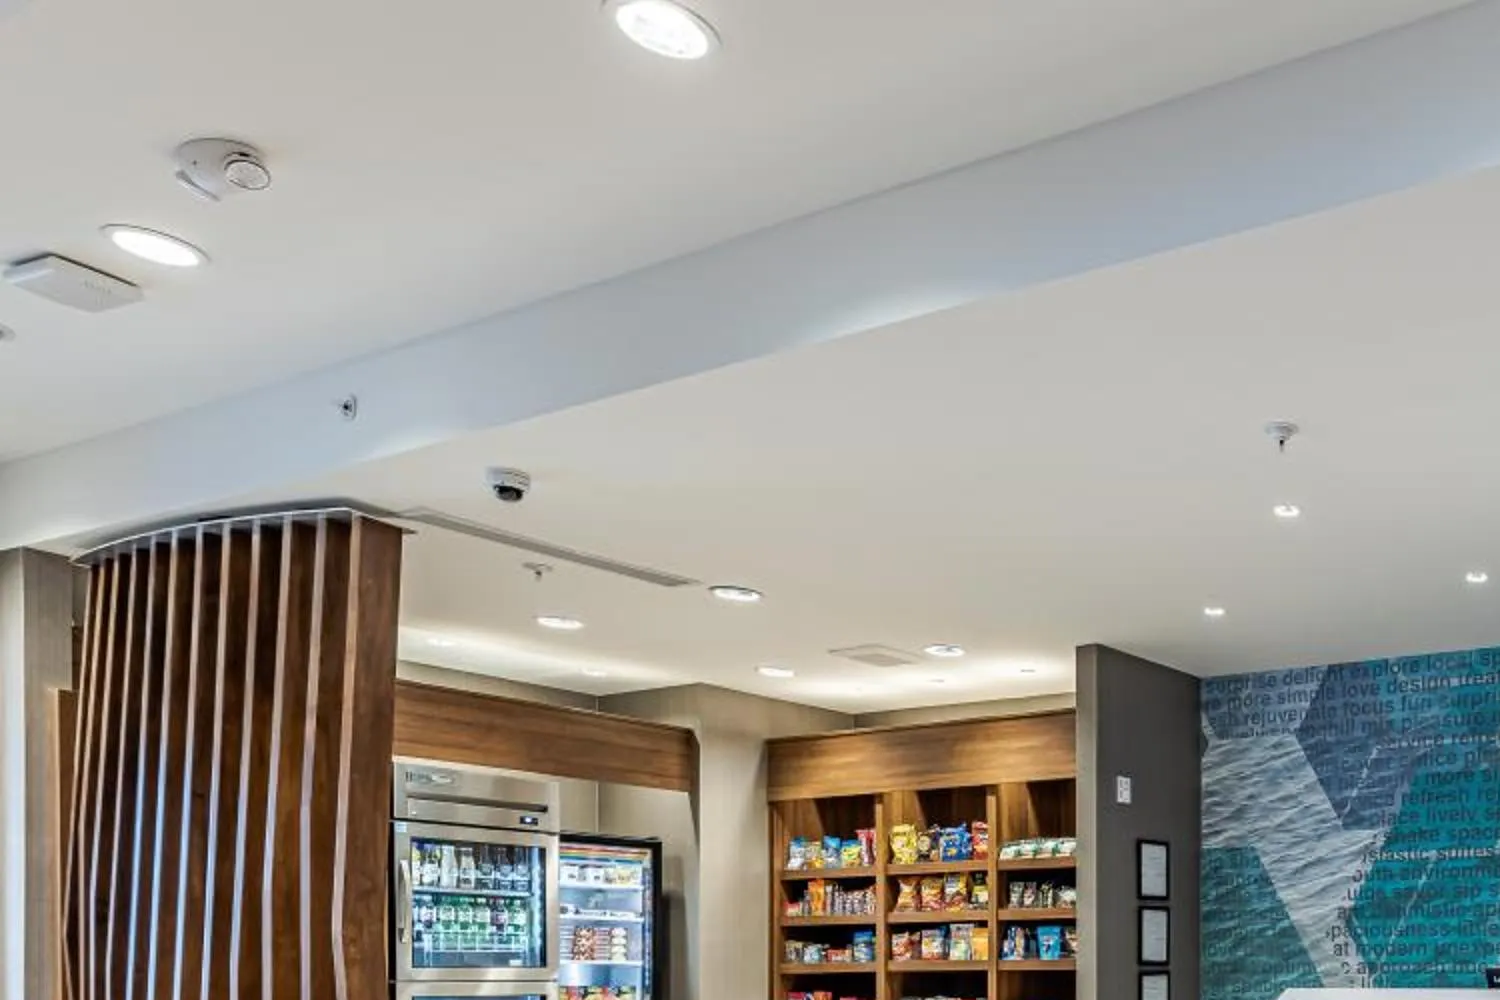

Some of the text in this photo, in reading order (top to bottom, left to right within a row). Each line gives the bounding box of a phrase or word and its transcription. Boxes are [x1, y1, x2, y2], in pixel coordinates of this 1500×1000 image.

[1342, 680, 1381, 699] love
[1343, 698, 1394, 717] focus
[1401, 692, 1432, 711] fun
